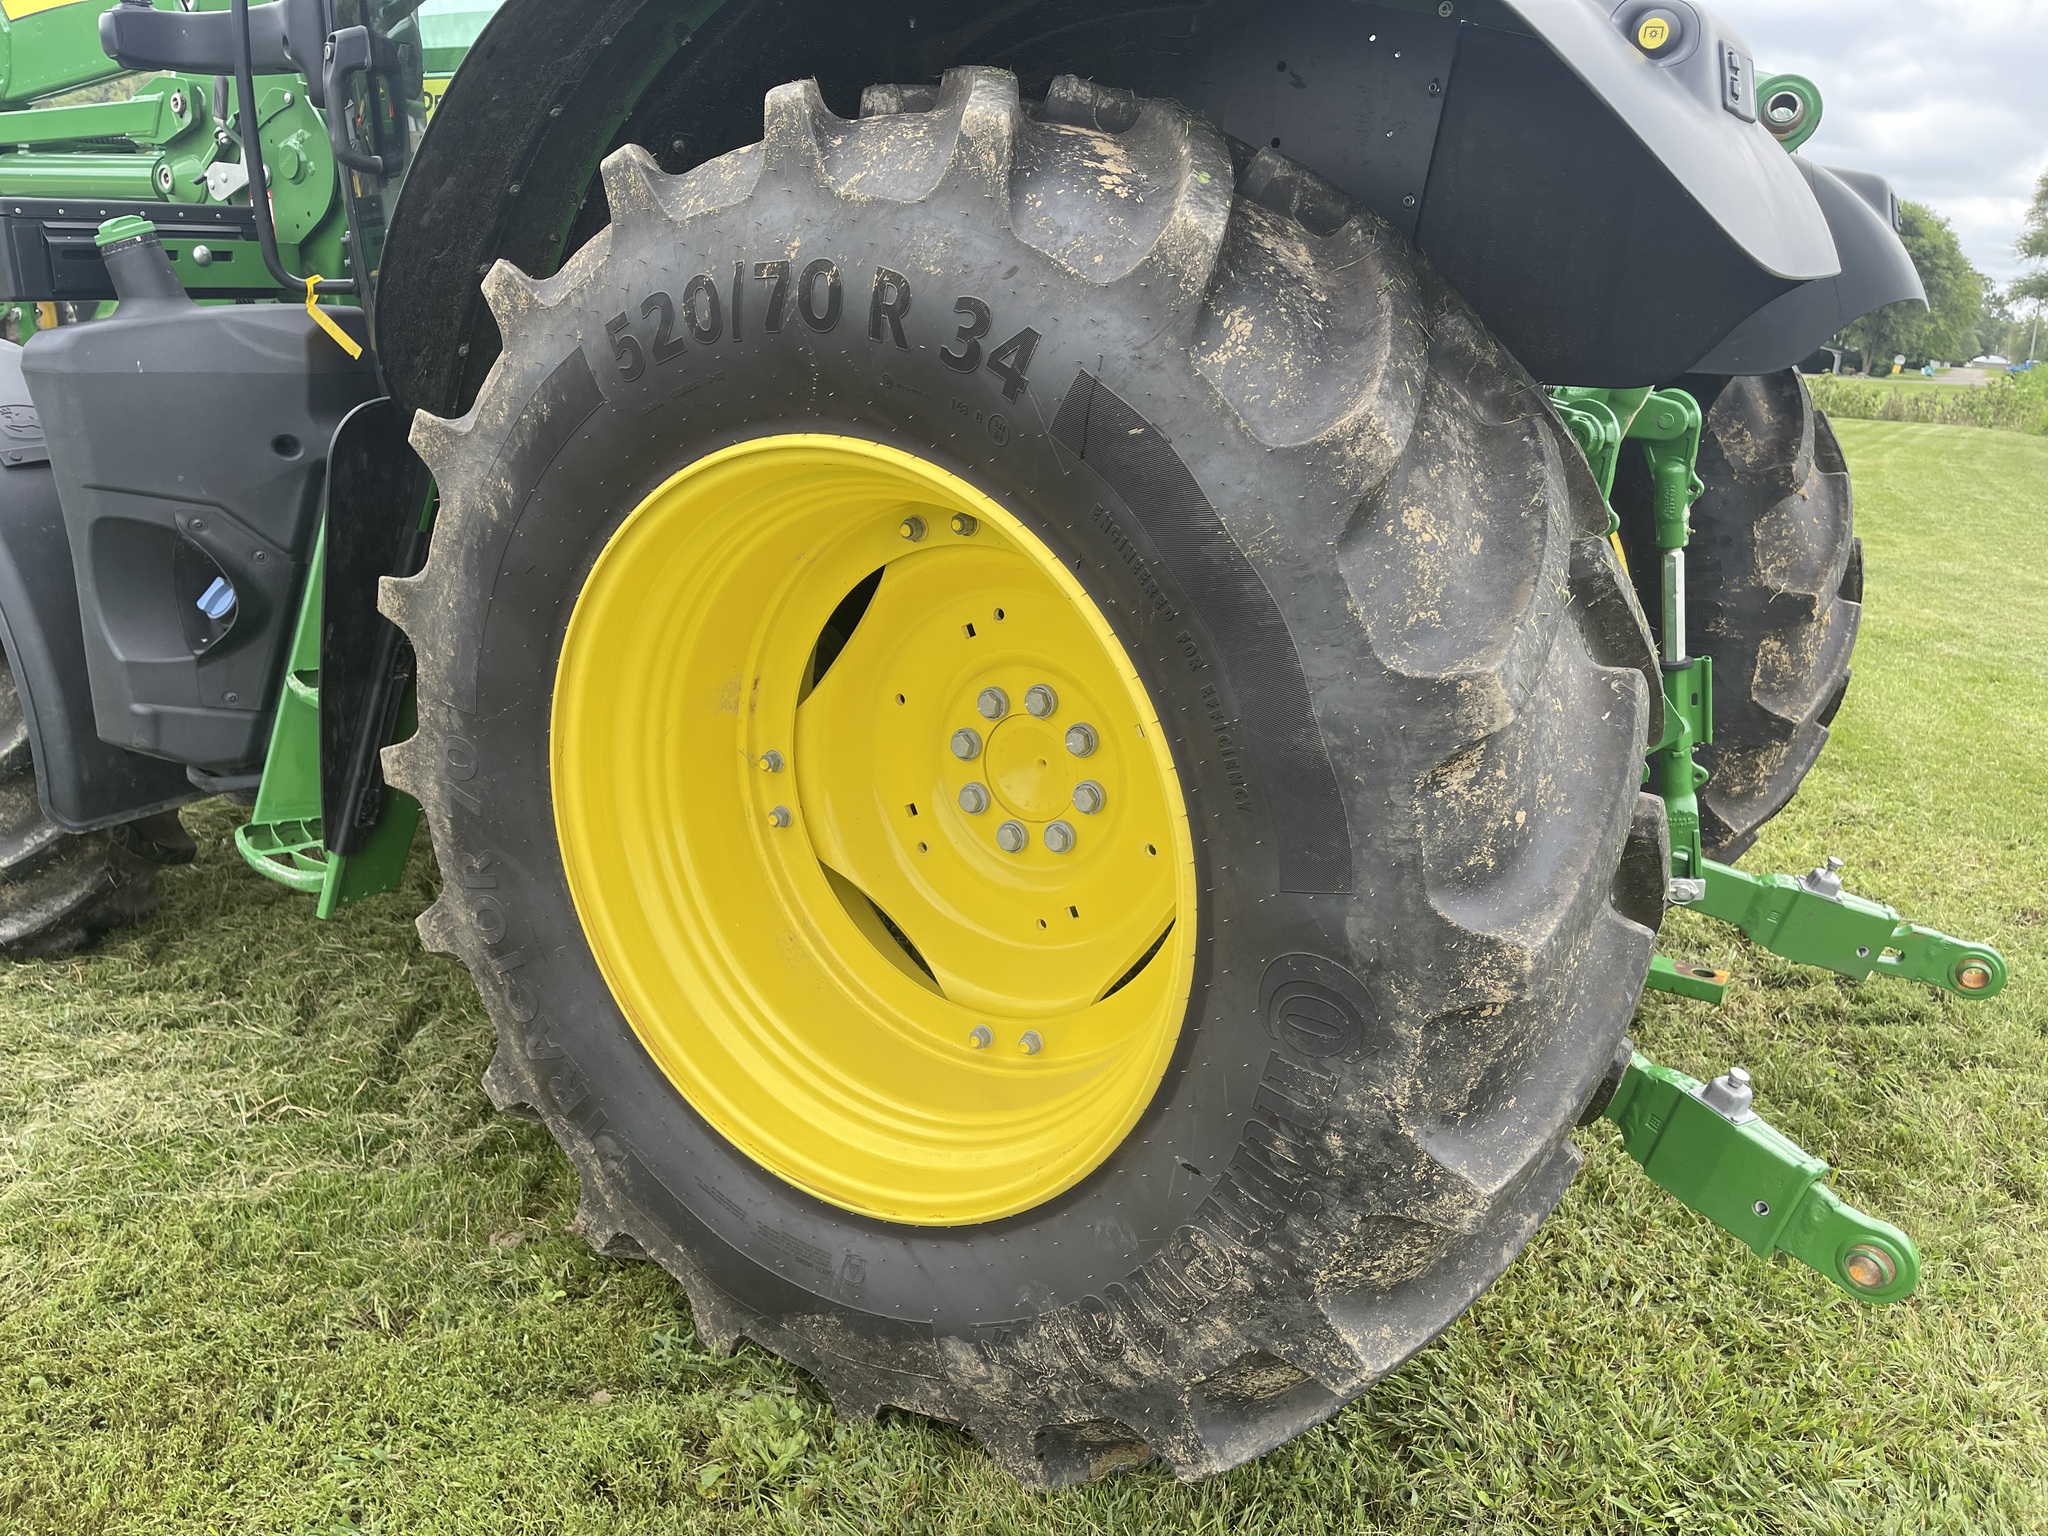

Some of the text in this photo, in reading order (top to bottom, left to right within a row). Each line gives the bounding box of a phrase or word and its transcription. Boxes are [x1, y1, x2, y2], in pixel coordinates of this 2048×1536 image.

[604, 256, 1043, 404] 520/70 R 34
[1090, 502, 1253, 814] ENGINEERED FOR EFFICIENCY
[441, 734, 610, 1152] TRACTOR 70
[1038, 951, 1381, 1387] Continental
